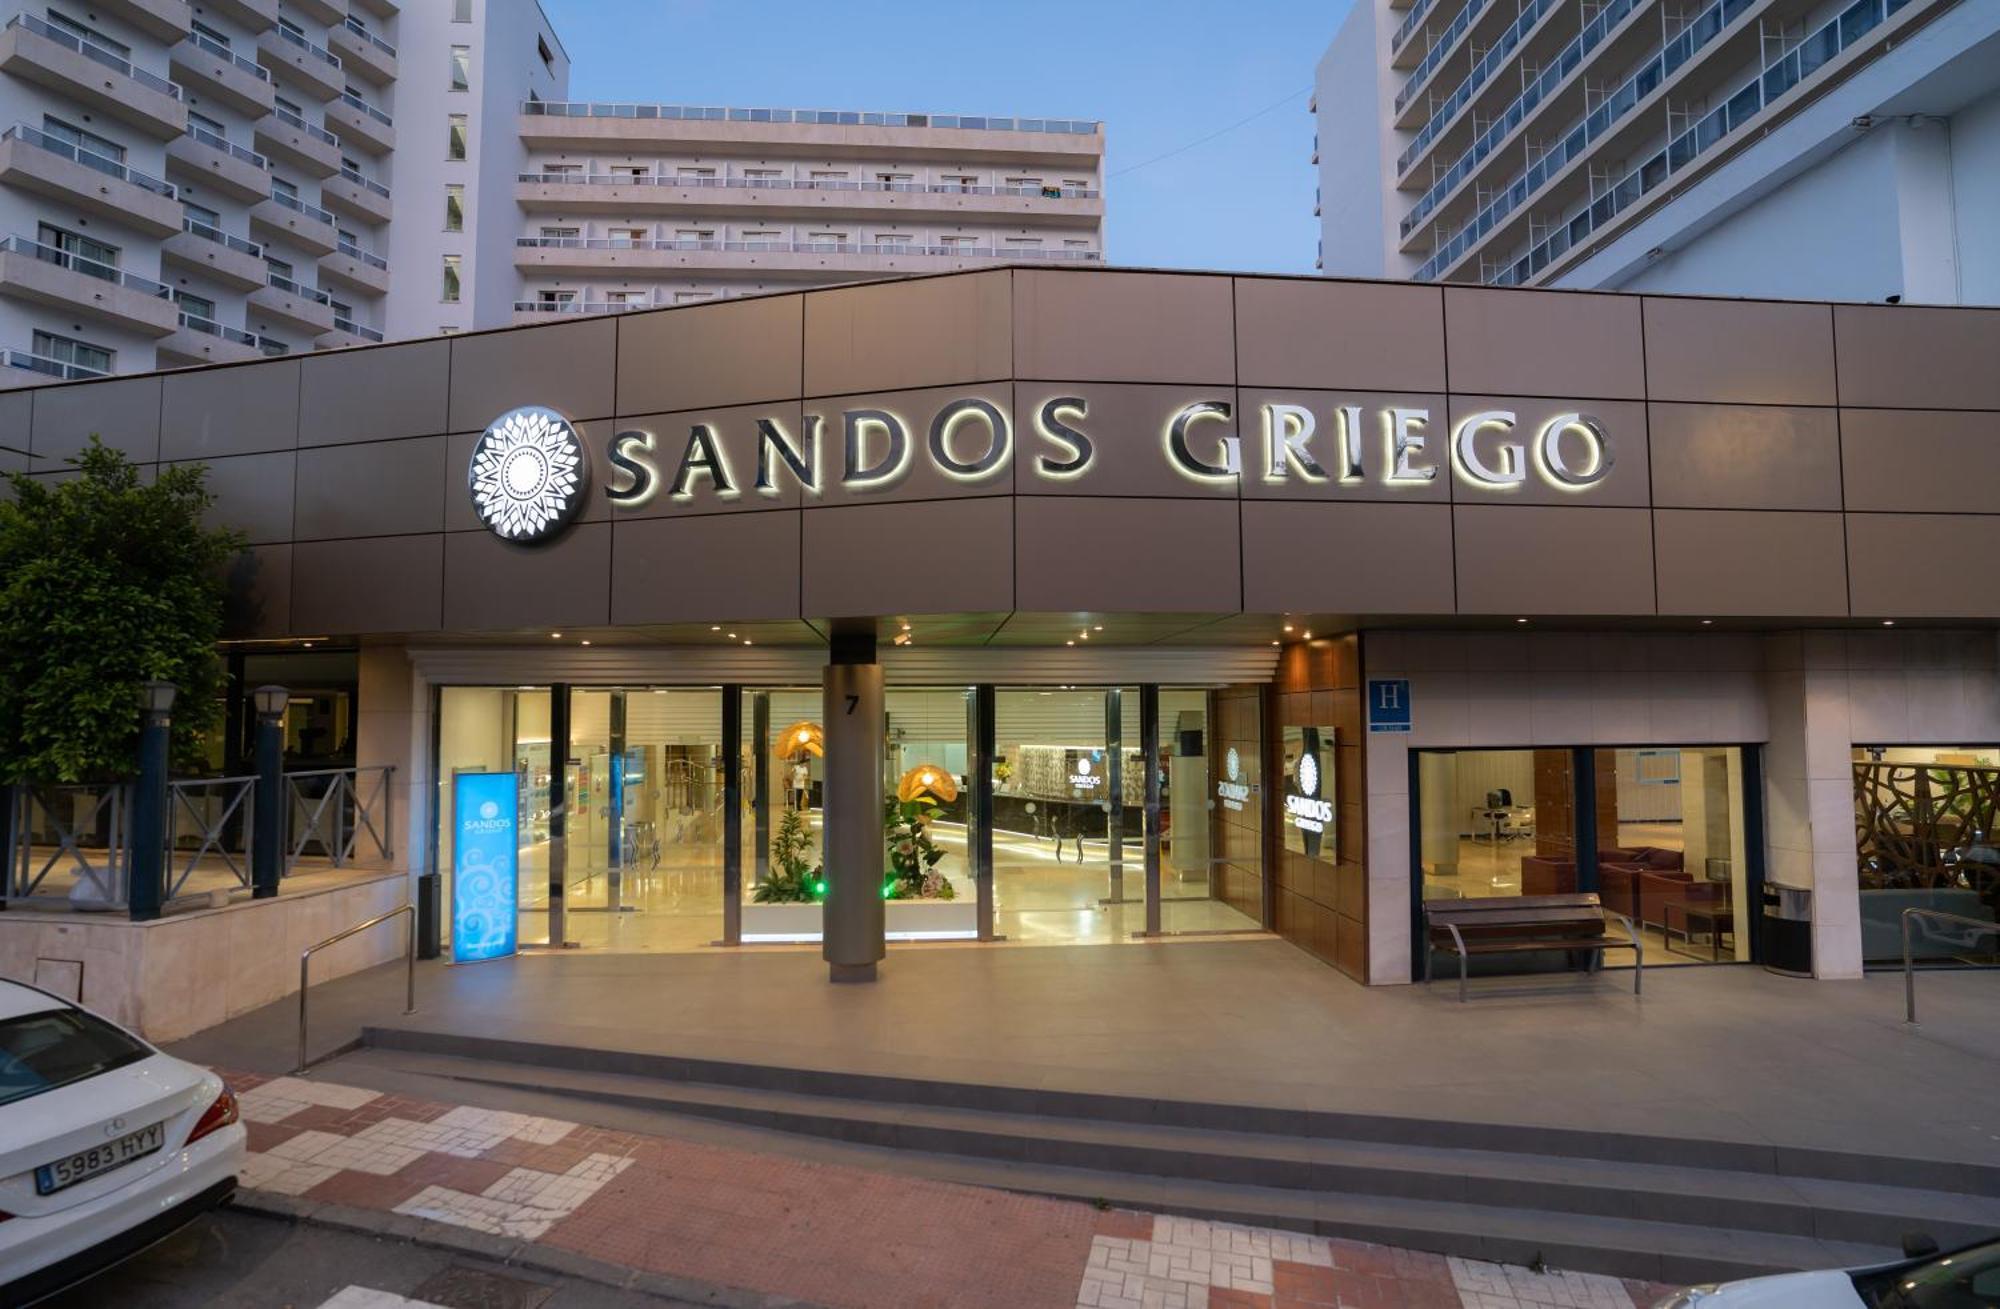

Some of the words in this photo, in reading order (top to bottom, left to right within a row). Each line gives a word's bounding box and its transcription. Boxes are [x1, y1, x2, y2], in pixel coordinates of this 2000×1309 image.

[604, 397, 1095, 505] SANDOS
[1162, 401, 1616, 491] GRIEGO
[845, 694, 859, 715] 7
[1379, 684, 1402, 709] H
[464, 818, 511, 830] SANDOS
[56, 1146, 115, 1181] 5983
[121, 1125, 158, 1157] HYY
